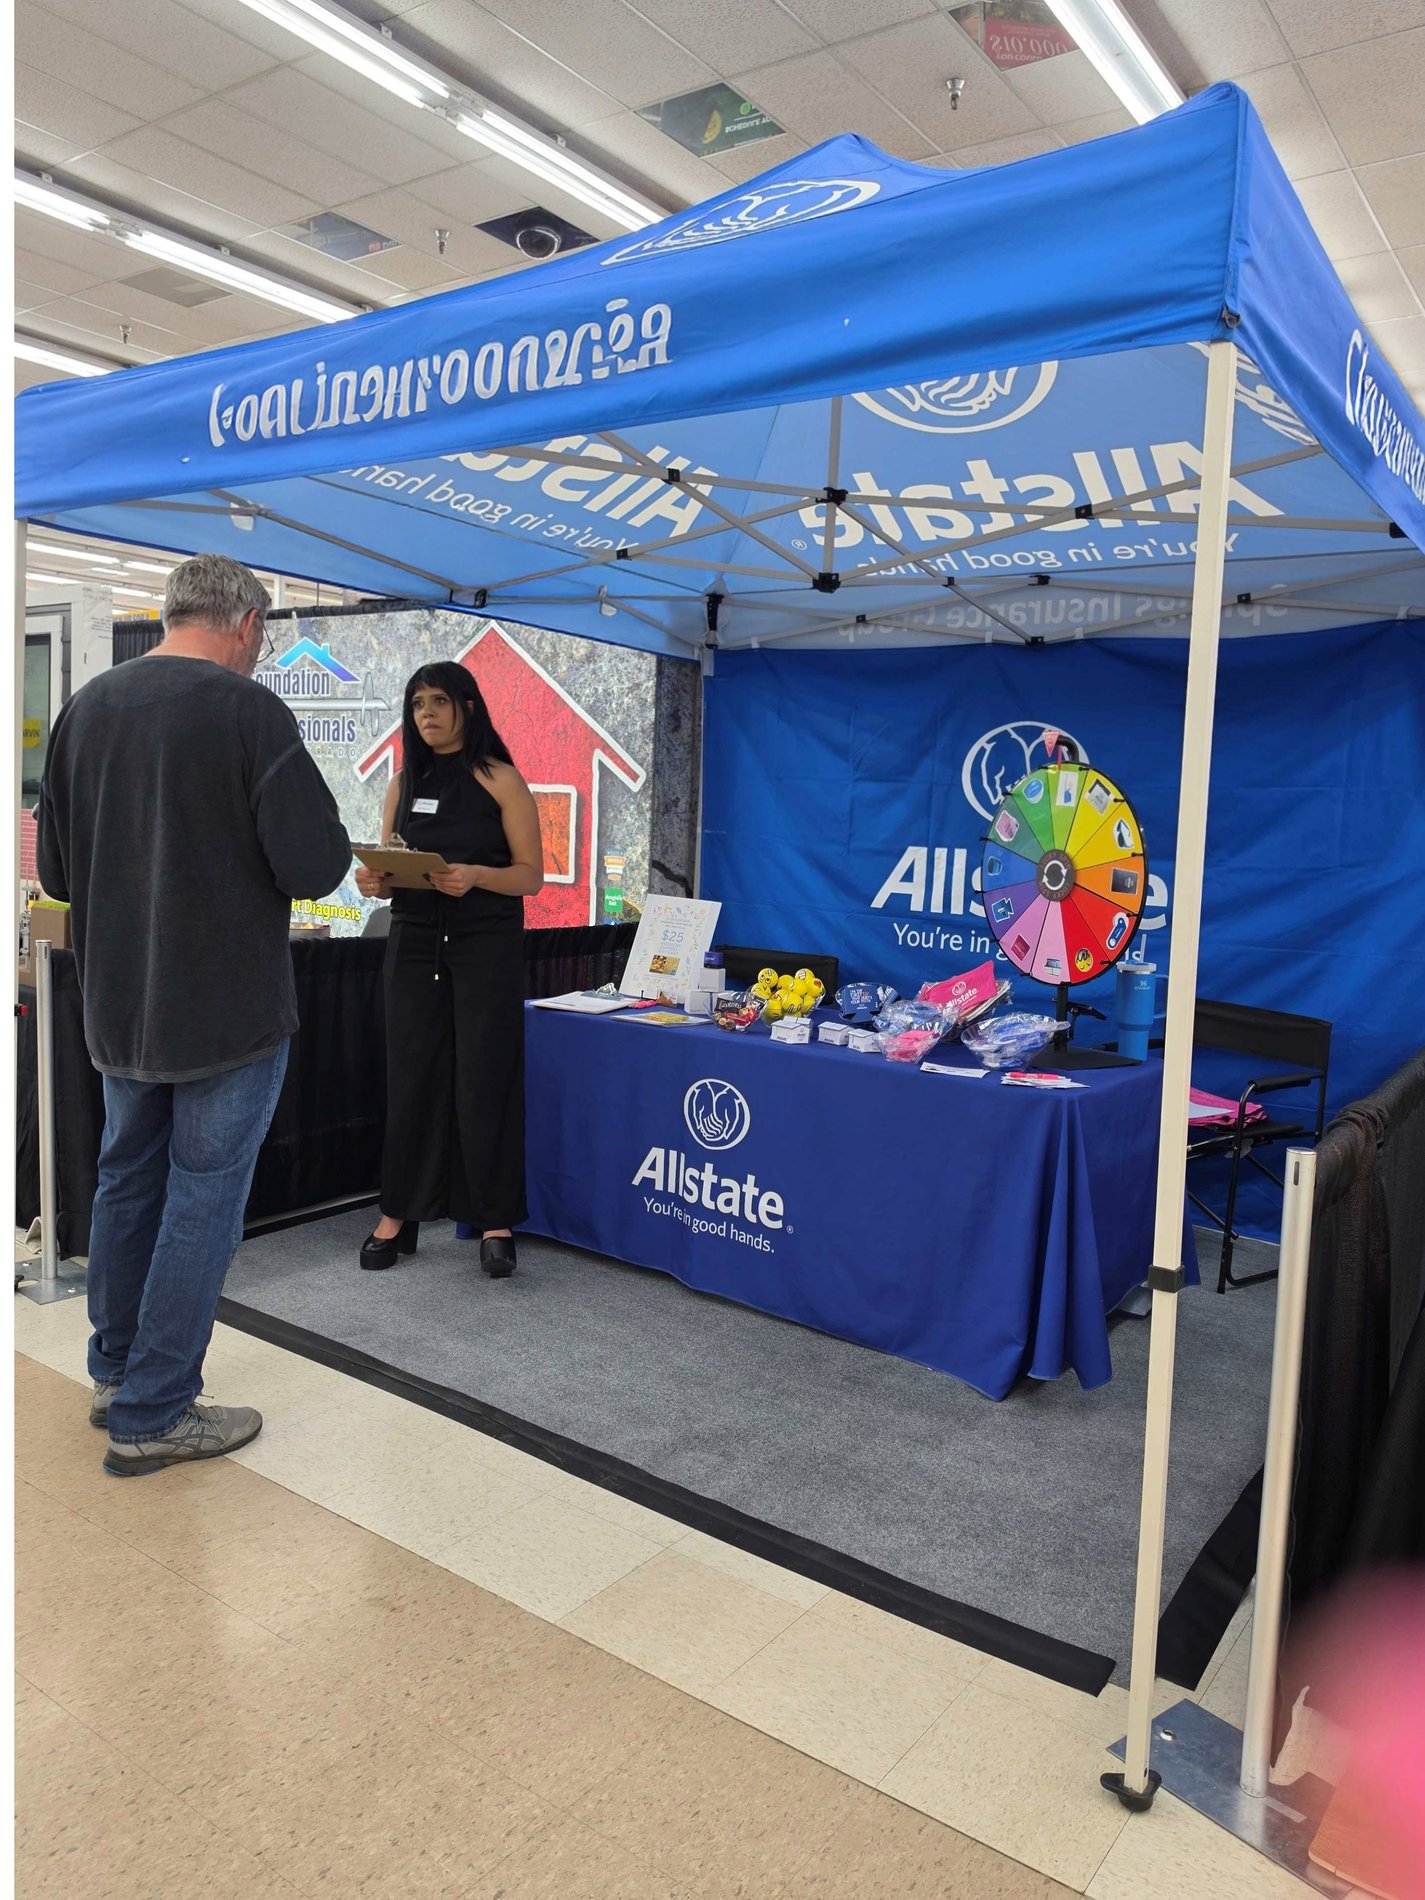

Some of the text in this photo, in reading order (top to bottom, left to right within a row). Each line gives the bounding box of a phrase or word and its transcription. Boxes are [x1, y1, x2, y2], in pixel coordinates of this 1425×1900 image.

[255, 669, 330, 696] oundation
[298, 715, 356, 742] sionals
[304, 899, 362, 921] Diagnosis
[660, 929, 685, 944] $25
[893, 922, 963, 952] You're
[970, 930, 990, 954] in
[631, 1146, 785, 1230] Allstate
[644, 1196, 683, 1222] You're
[692, 1216, 727, 1237] good
[730, 1223, 776, 1254] hands.
